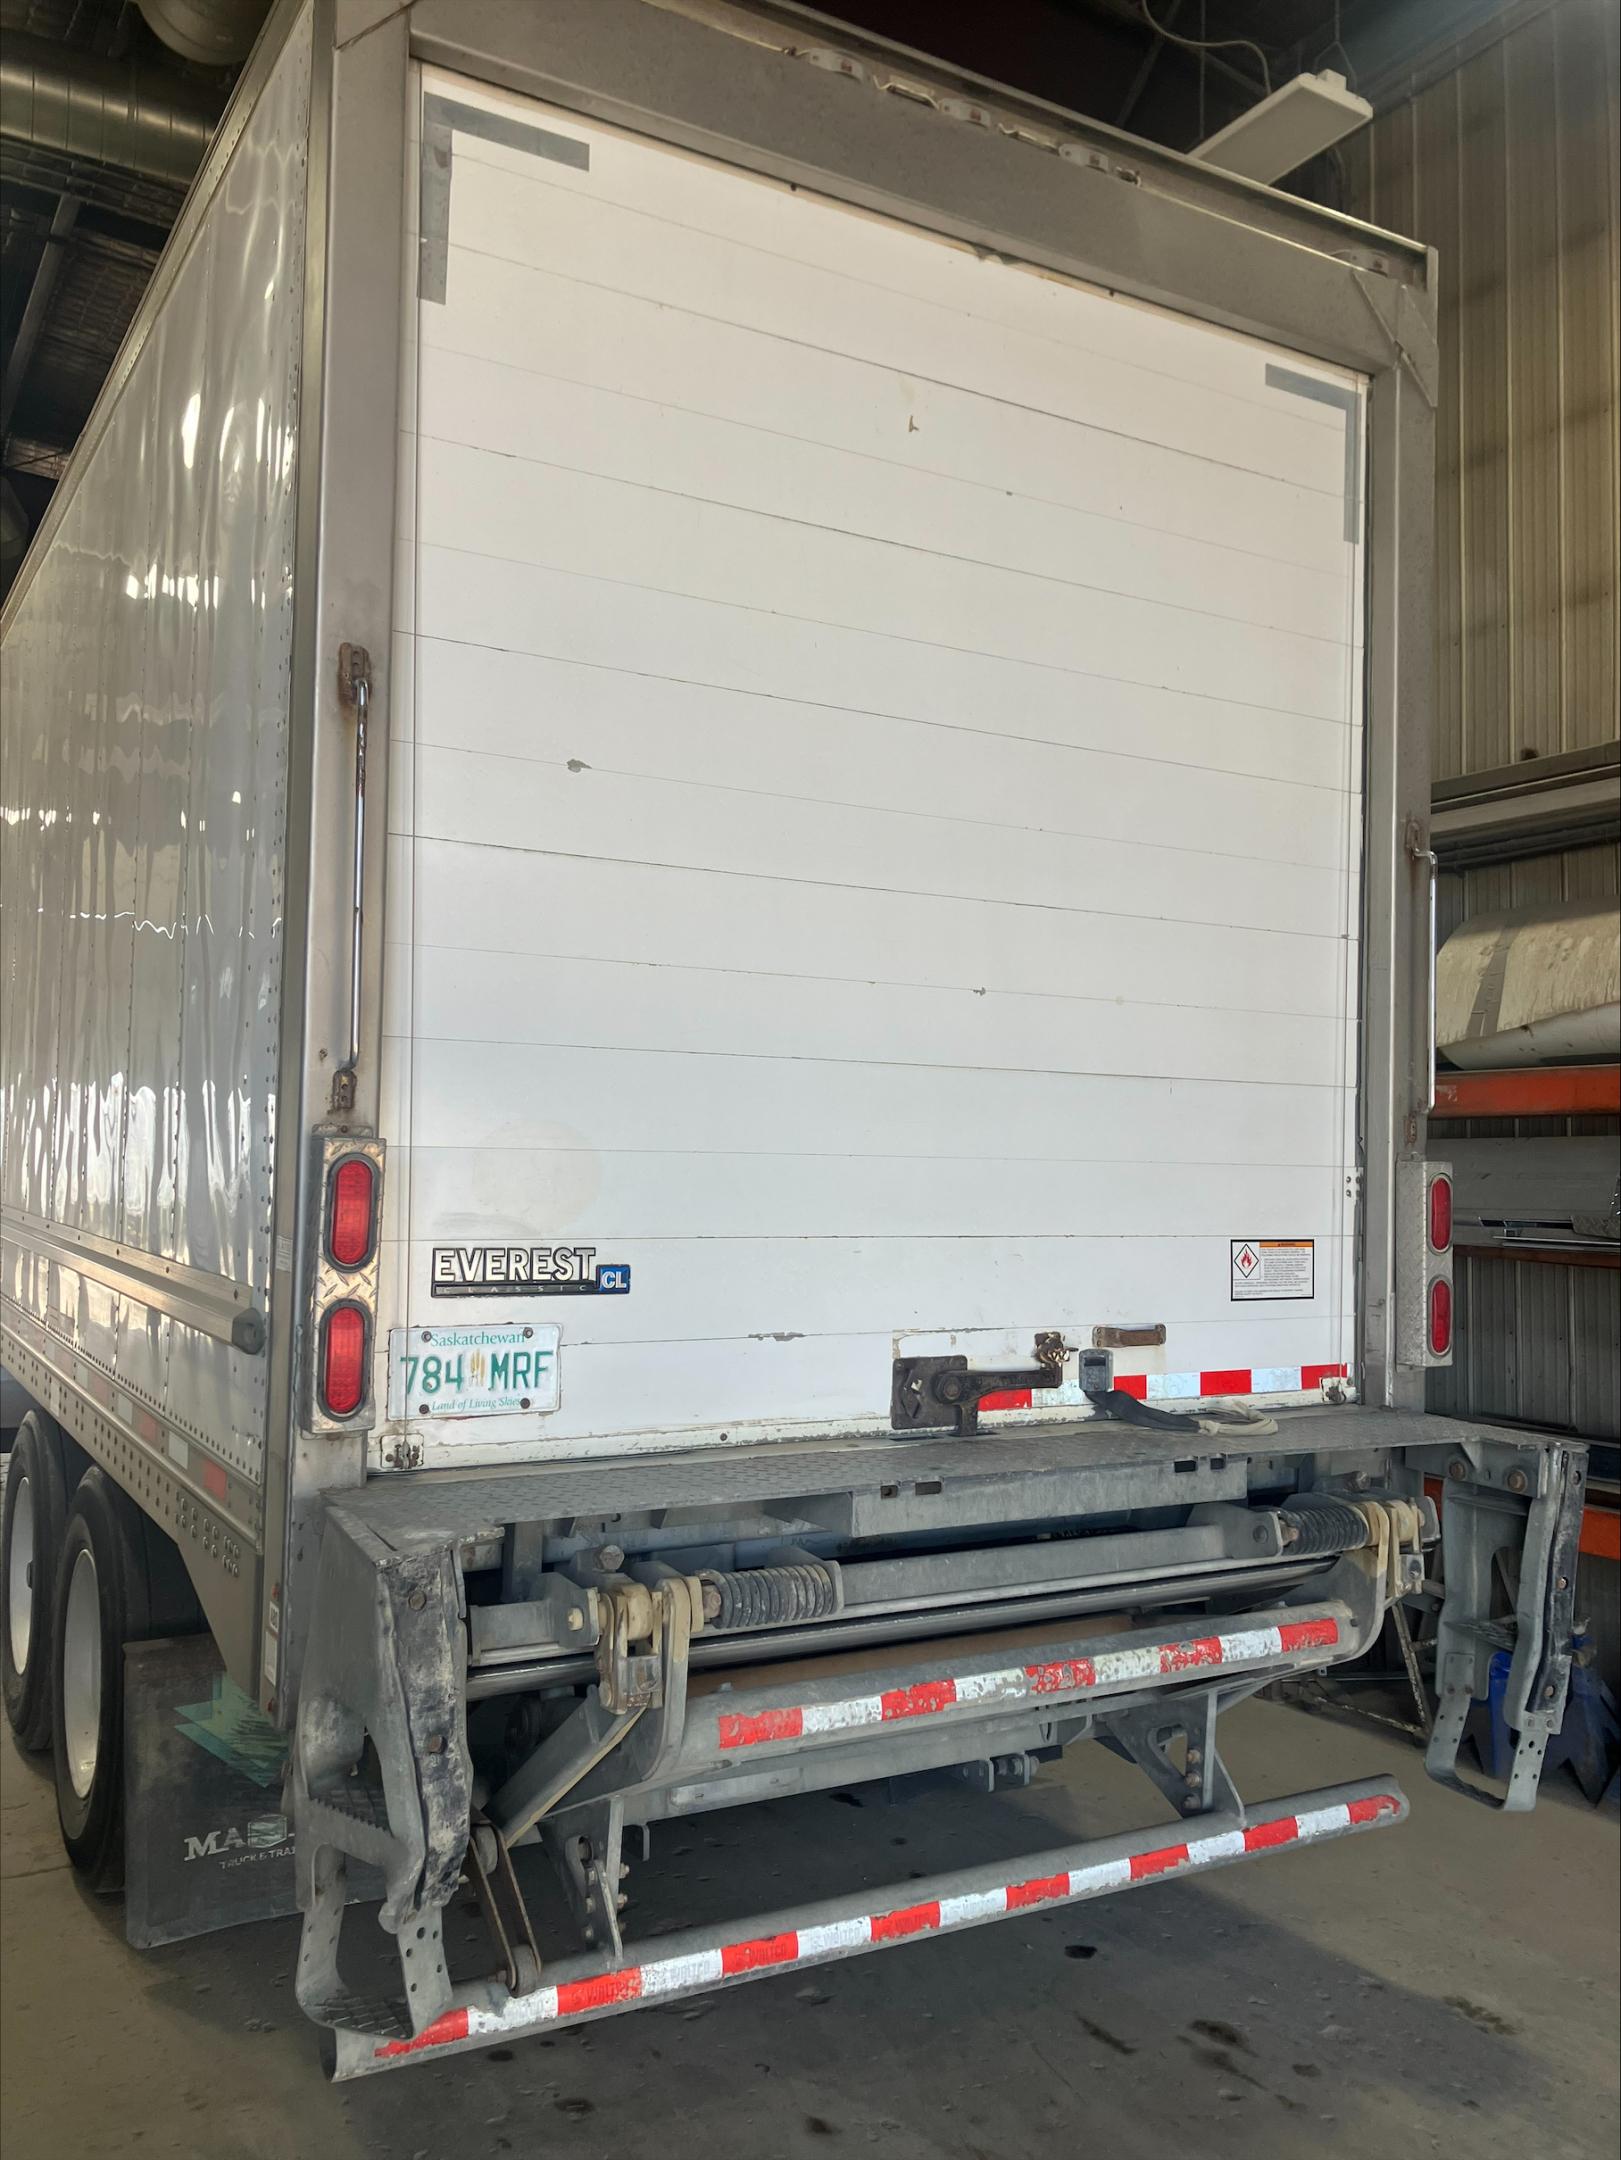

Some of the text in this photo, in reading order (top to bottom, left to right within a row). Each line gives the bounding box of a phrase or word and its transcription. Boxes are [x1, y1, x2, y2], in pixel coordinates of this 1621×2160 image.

[433, 1247, 627, 1289] EVEREST CL
[443, 1284, 586, 1294] CLASSIC
[431, 1331, 525, 1347] Saskatchewan
[400, 1351, 554, 1394] 784 MRF
[432, 1396, 520, 1412] Land of Living Skies
[219, 1853, 257, 1869] TRUCK
